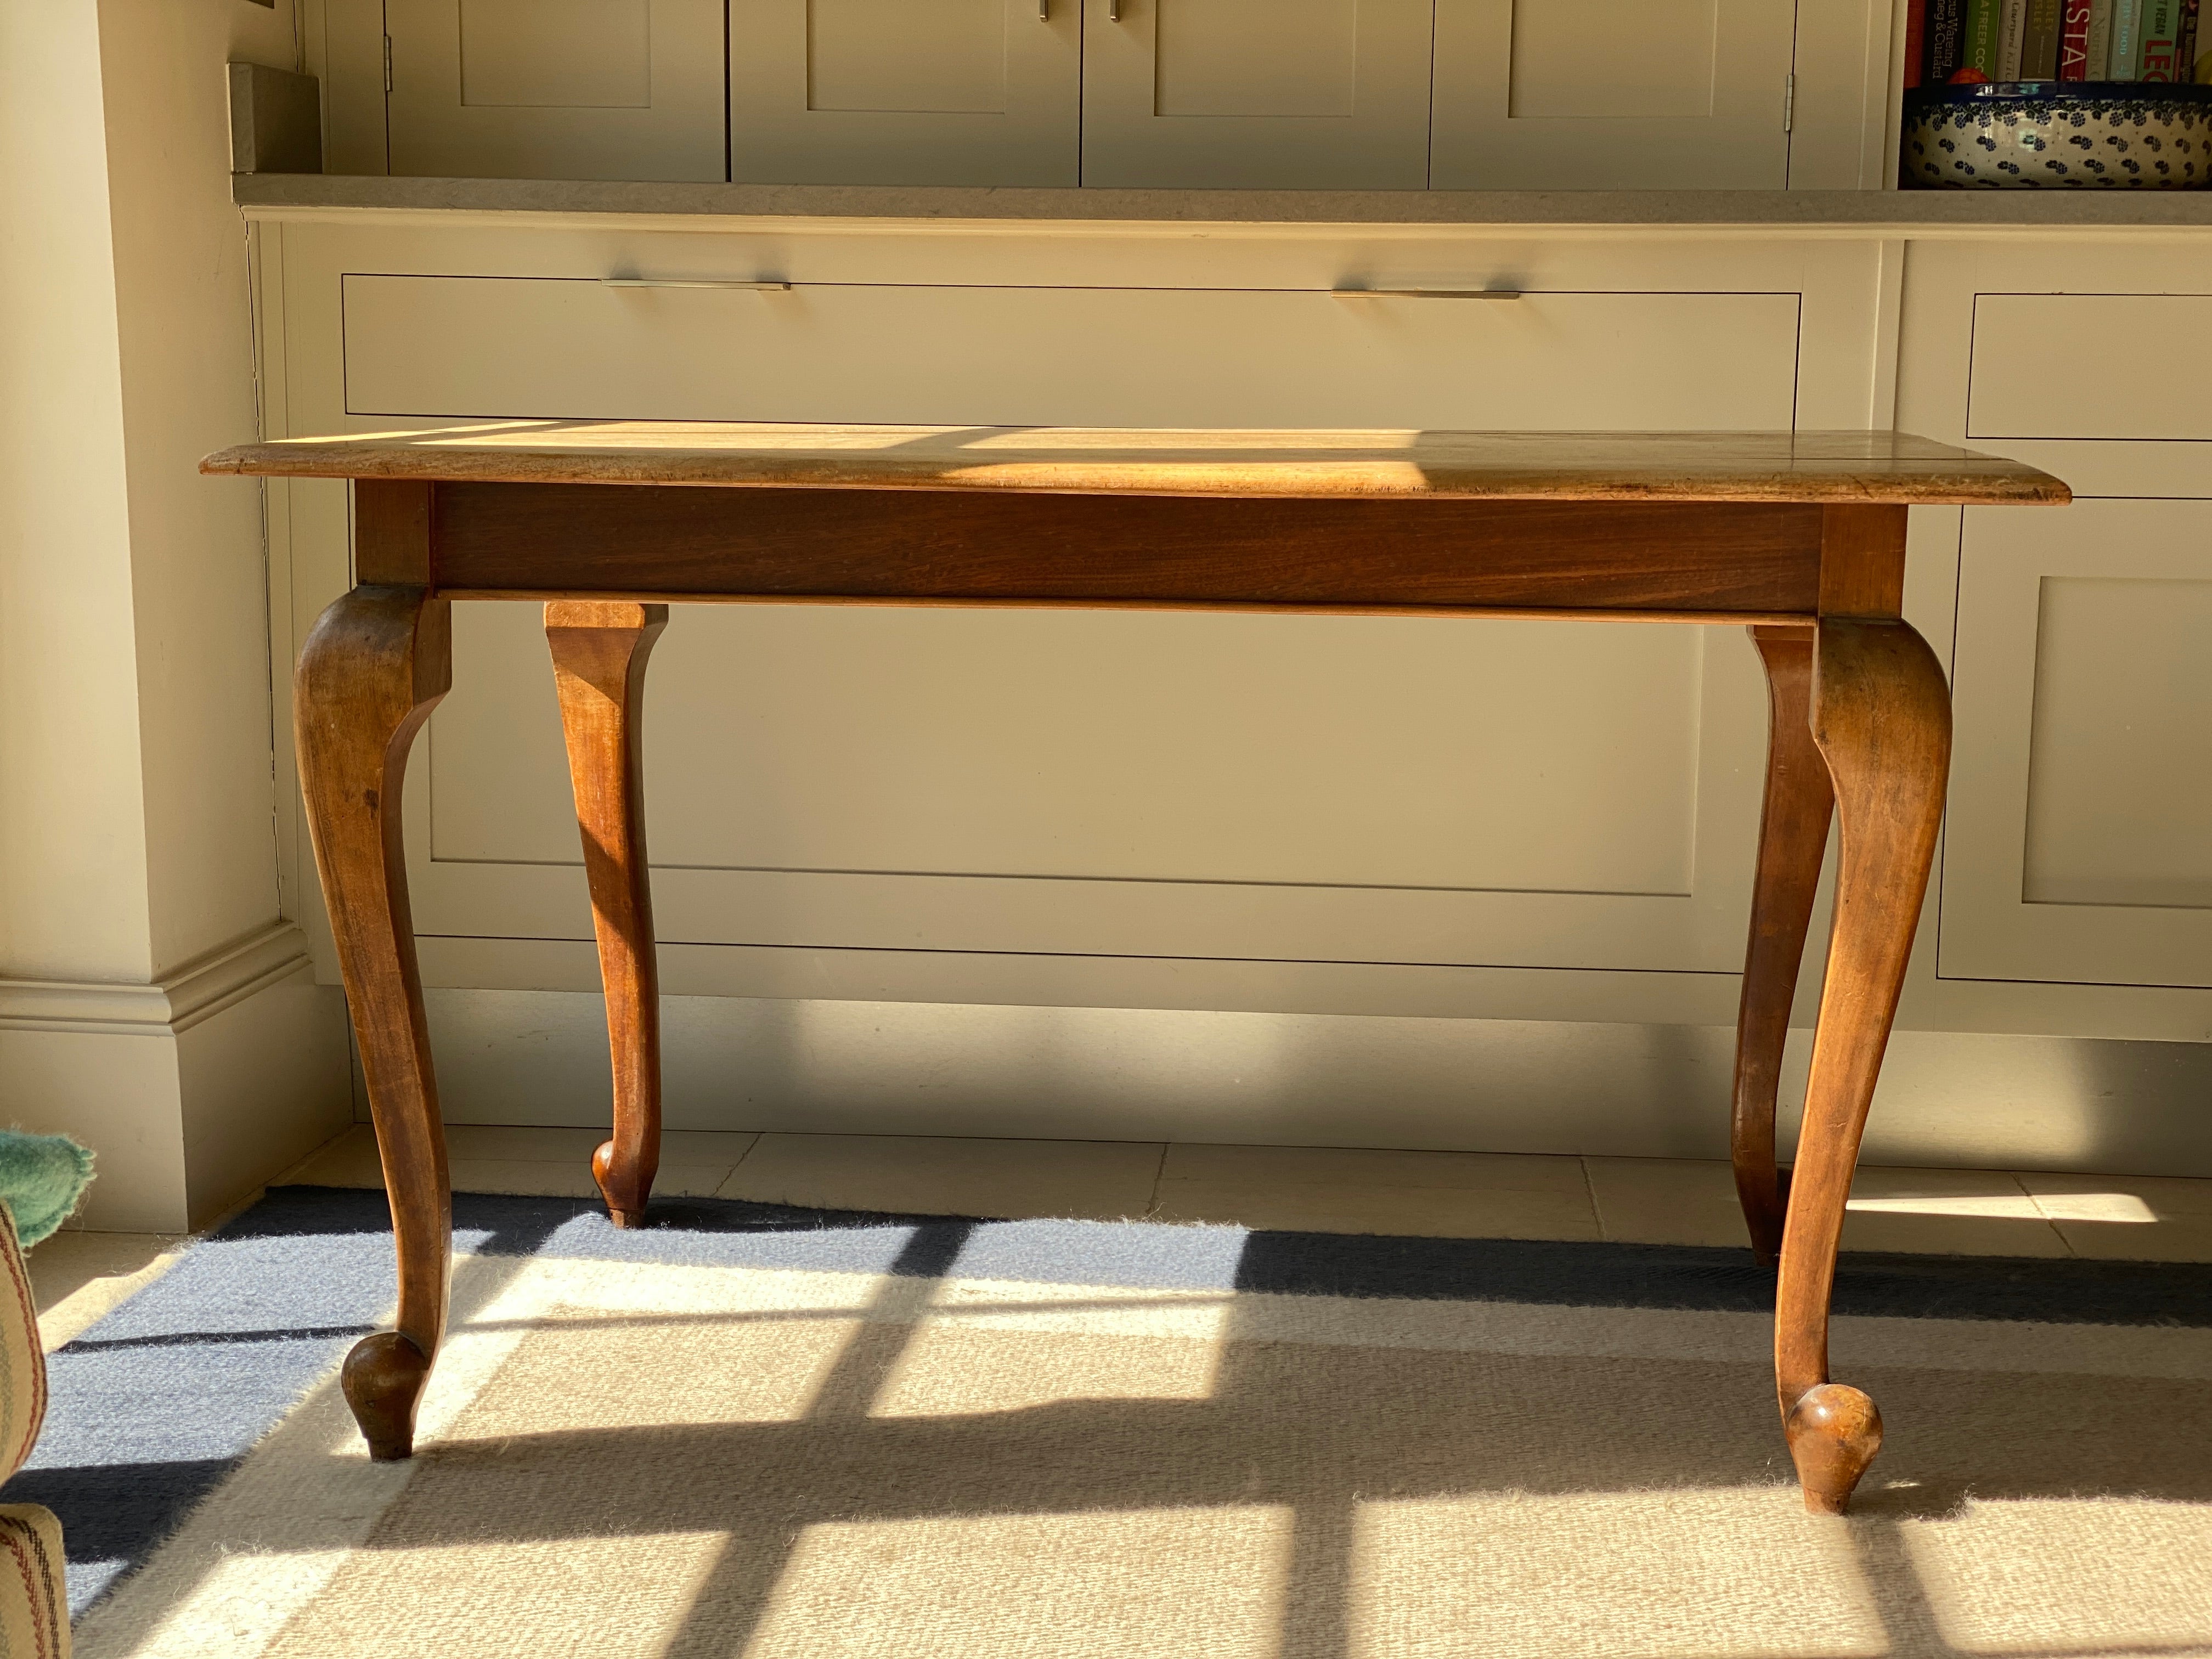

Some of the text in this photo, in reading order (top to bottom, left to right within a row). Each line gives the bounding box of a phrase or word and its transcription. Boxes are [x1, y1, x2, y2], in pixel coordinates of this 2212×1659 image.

[1936, 22, 1946, 32] &
[1942, 18, 1957, 67] Wareing
[1976, 11, 1989, 45] FREER
[1933, 33, 1946, 79] Custard
